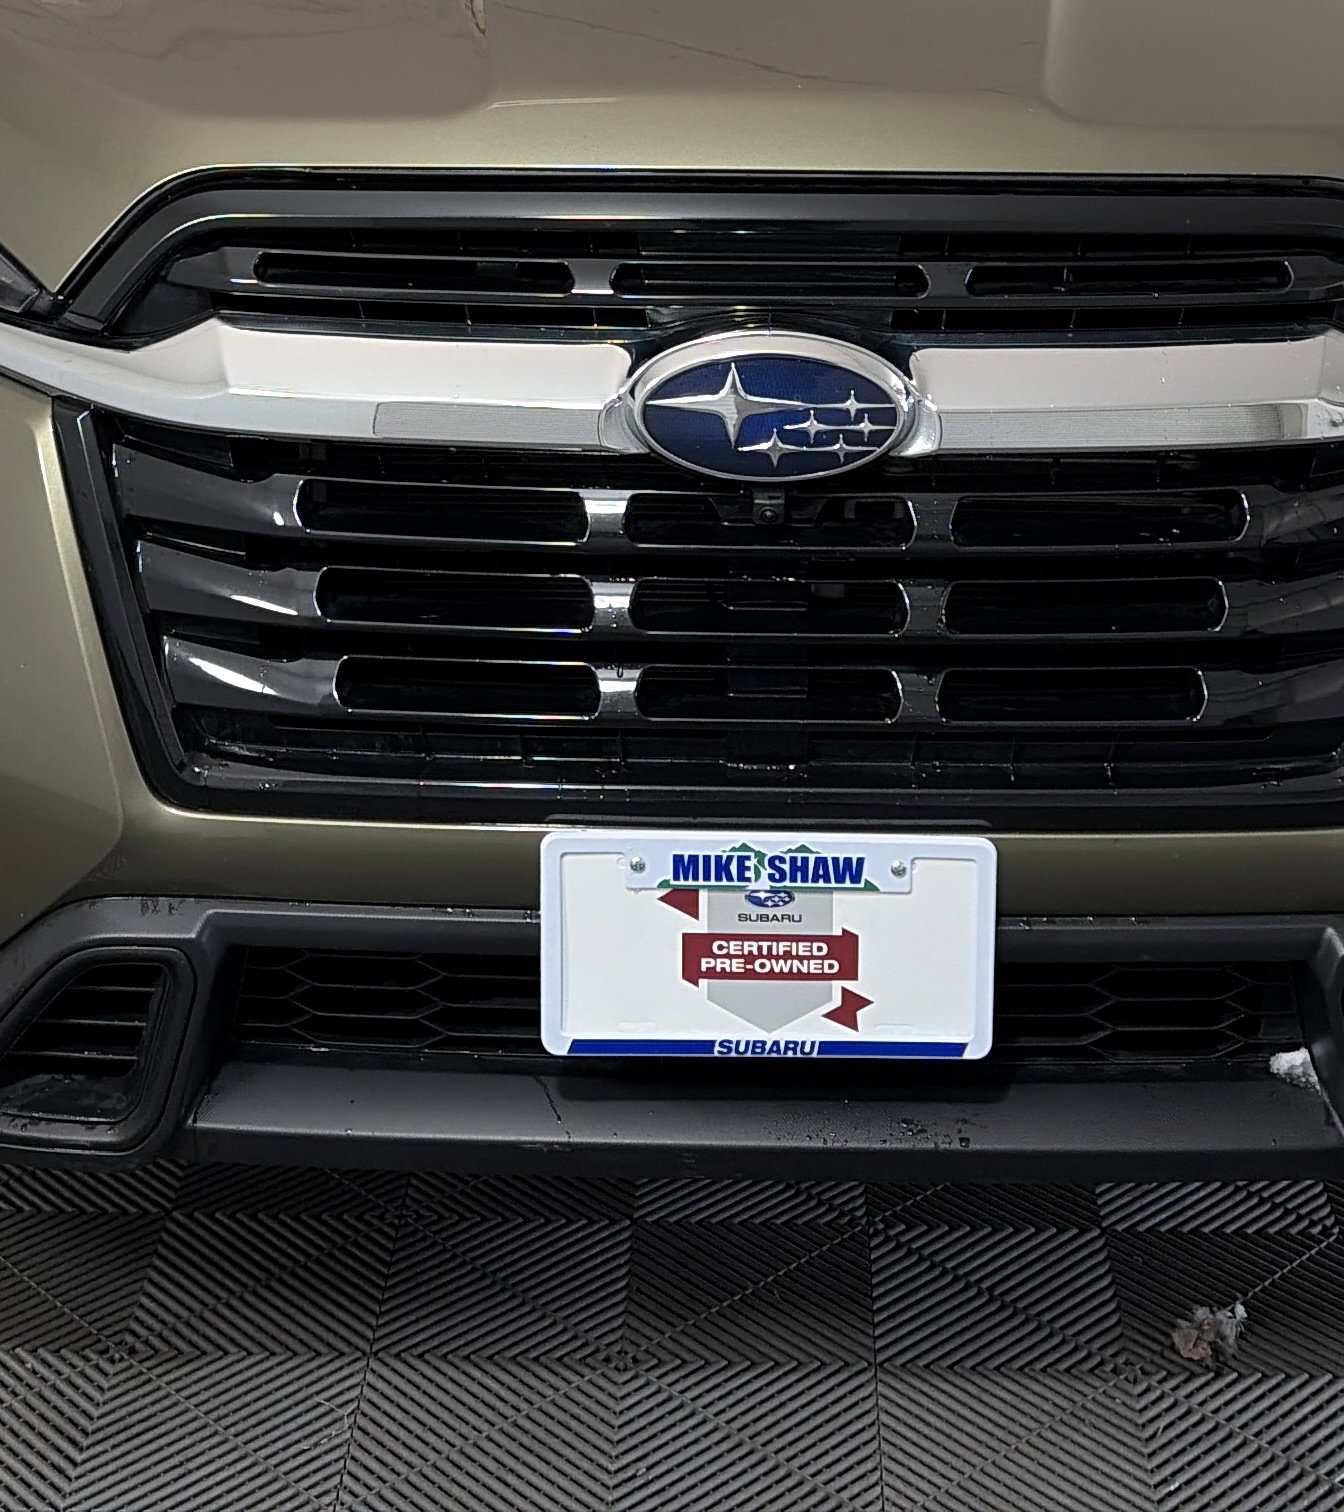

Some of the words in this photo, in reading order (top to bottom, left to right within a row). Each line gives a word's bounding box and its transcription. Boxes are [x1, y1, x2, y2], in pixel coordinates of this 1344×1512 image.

[672, 853, 752, 883] MIKE
[767, 855, 866, 884] SHAW
[737, 913, 802, 923] SUBARU
[711, 940, 829, 956] CERTIFIED
[700, 957, 840, 974] PRE-OWNED
[716, 1039, 817, 1056] SUBARU
